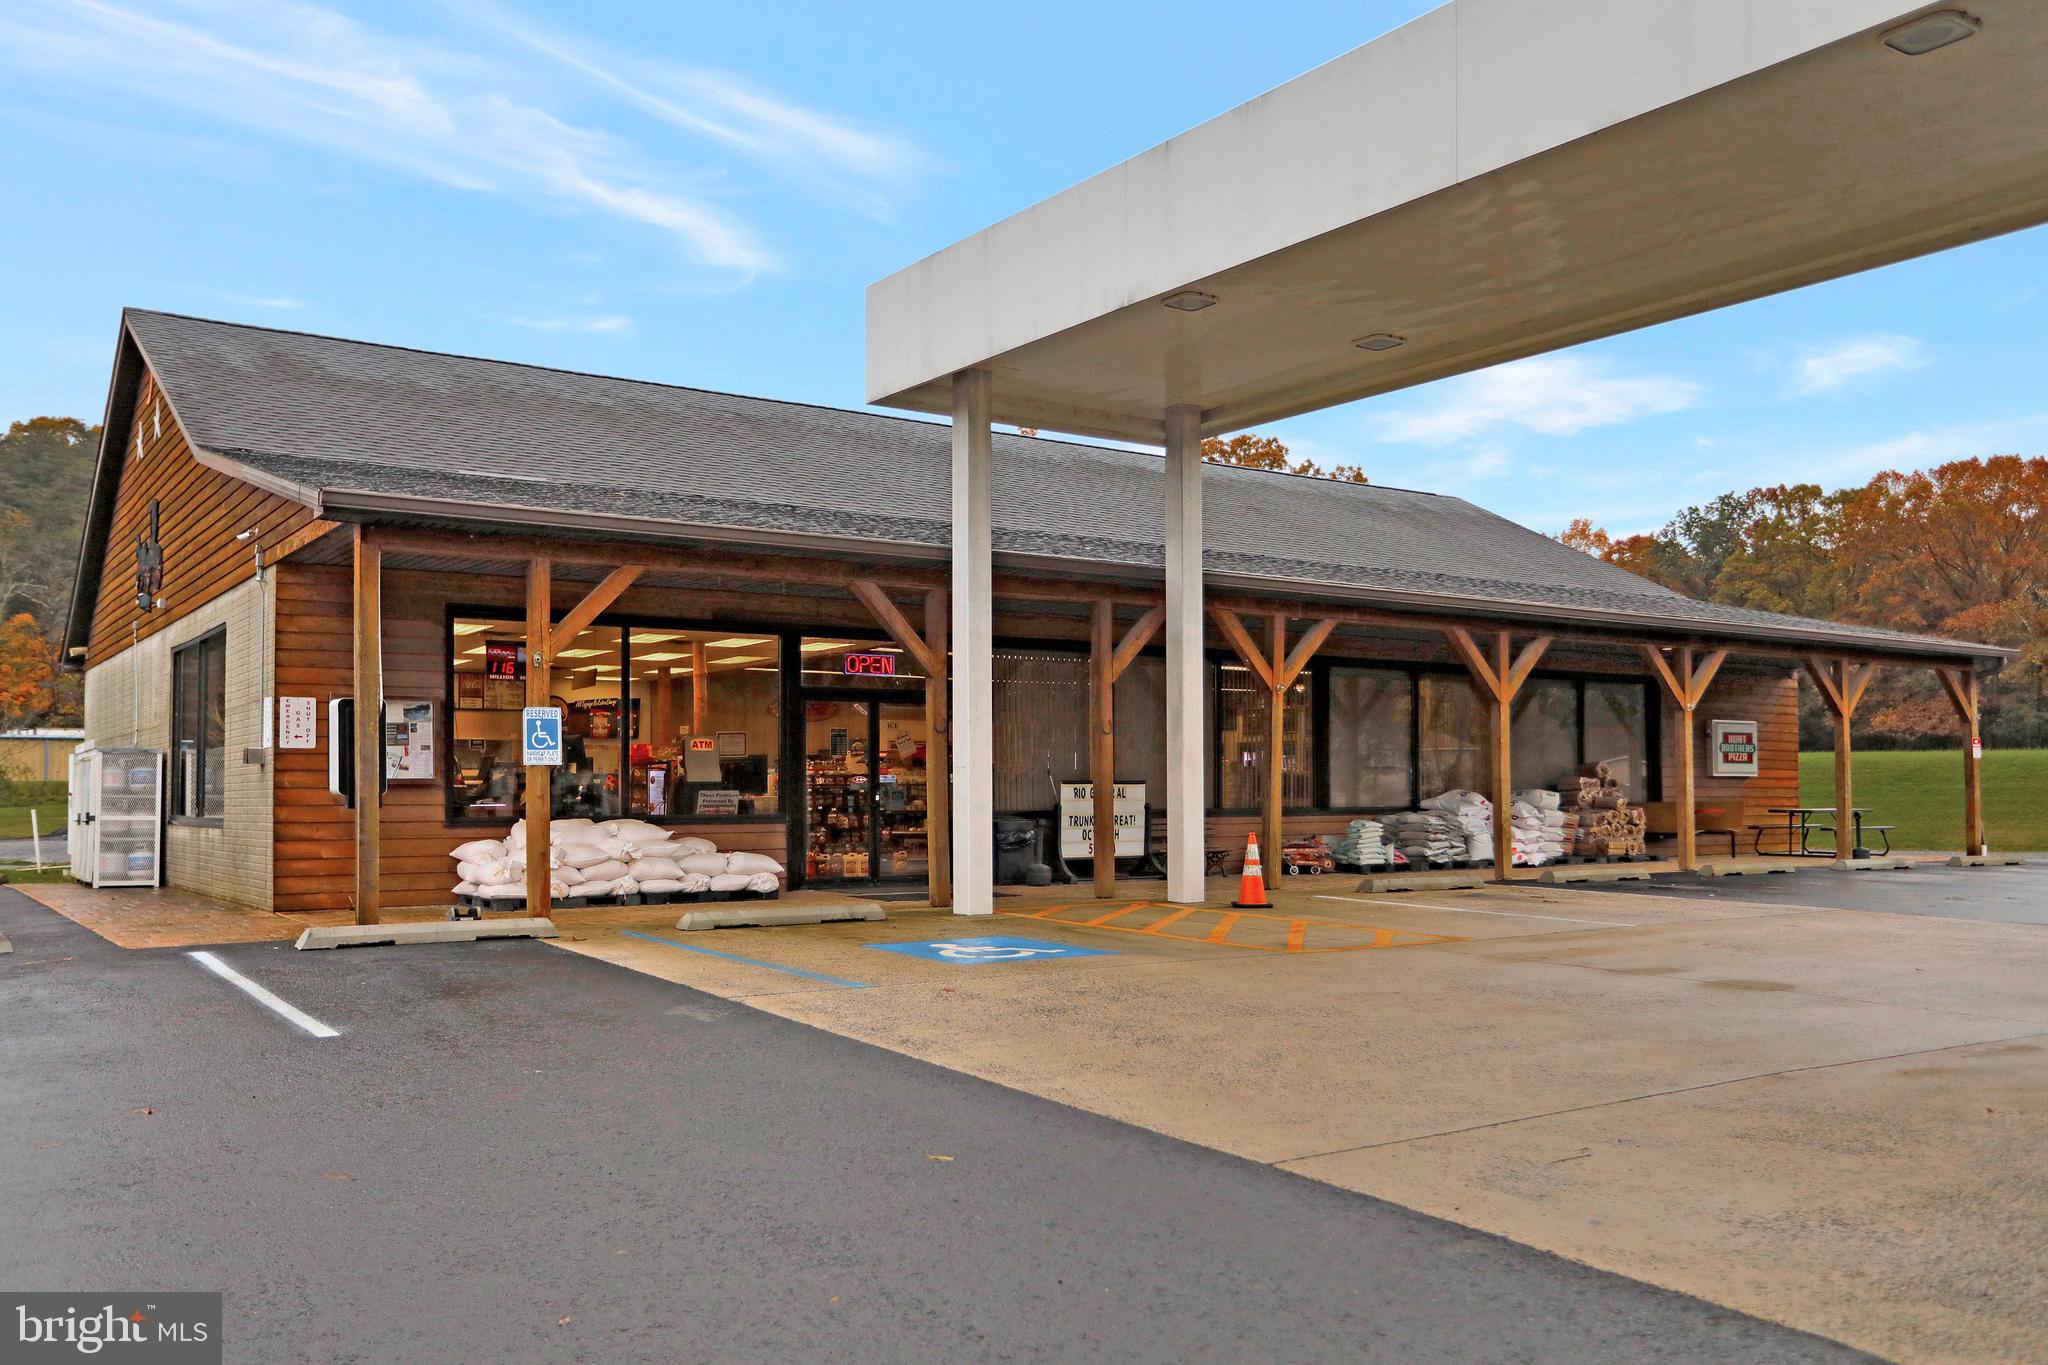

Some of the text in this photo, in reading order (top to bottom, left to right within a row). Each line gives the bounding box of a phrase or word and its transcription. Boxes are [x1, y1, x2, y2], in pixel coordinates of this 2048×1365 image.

[492, 661, 515, 674] 116
[847, 655, 893, 674] OPEN
[526, 709, 558, 718] RESERVED
[1728, 735, 1746, 743] HUNT
[692, 741, 713, 749] ATM
[1721, 744, 1754, 752] BROTHERS
[1728, 753, 1748, 761] PIZZA
[1073, 787, 1086, 799] RIO
[1114, 815, 1136, 826] REAT!
